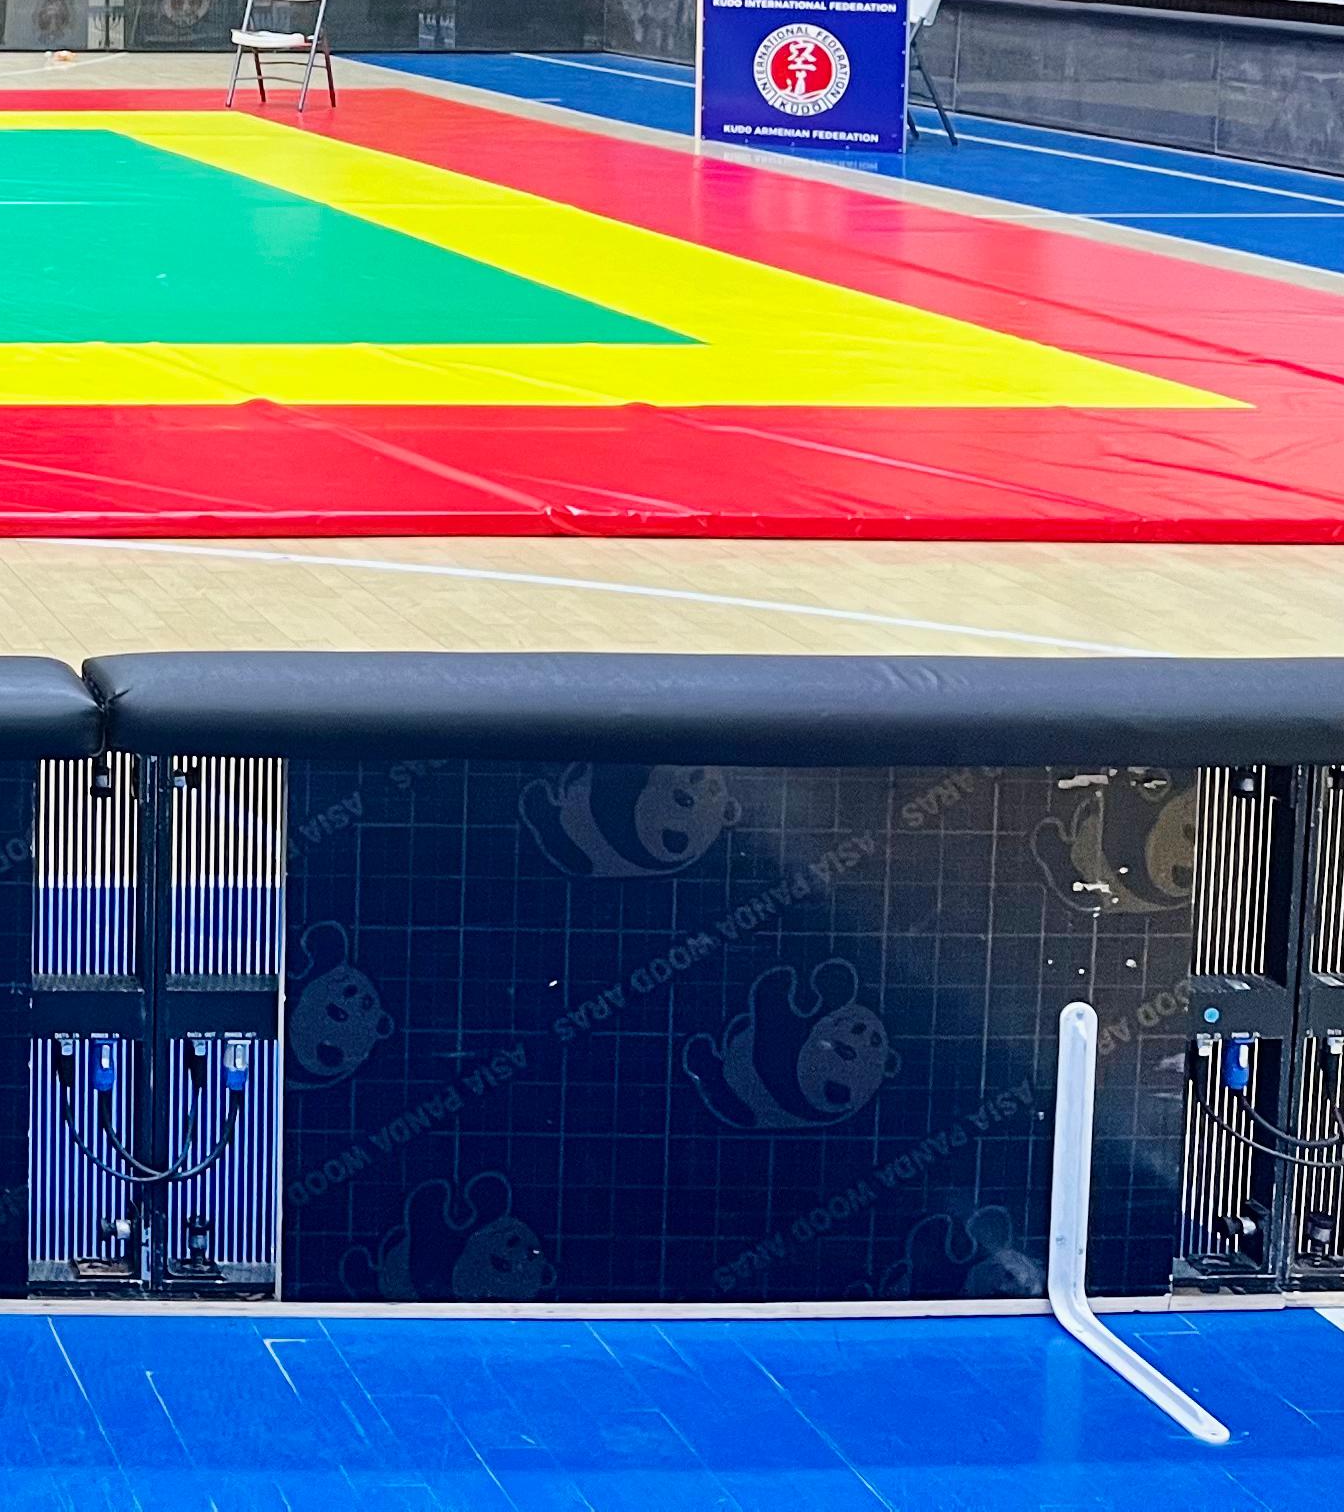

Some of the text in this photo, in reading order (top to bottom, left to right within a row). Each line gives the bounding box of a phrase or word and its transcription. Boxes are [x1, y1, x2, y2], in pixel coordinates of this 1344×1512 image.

[745, 0, 827, 11] INTERNATIONAL
[829, 2, 897, 13] FEDERATION
[723, 124, 879, 143] KUDO ARMENIAN FEDERATION
[716, 872, 810, 939] PANDA
[630, 930, 718, 994] WOOD
[552, 984, 627, 1041] ARAS
[368, 1085, 464, 1153] PANDA
